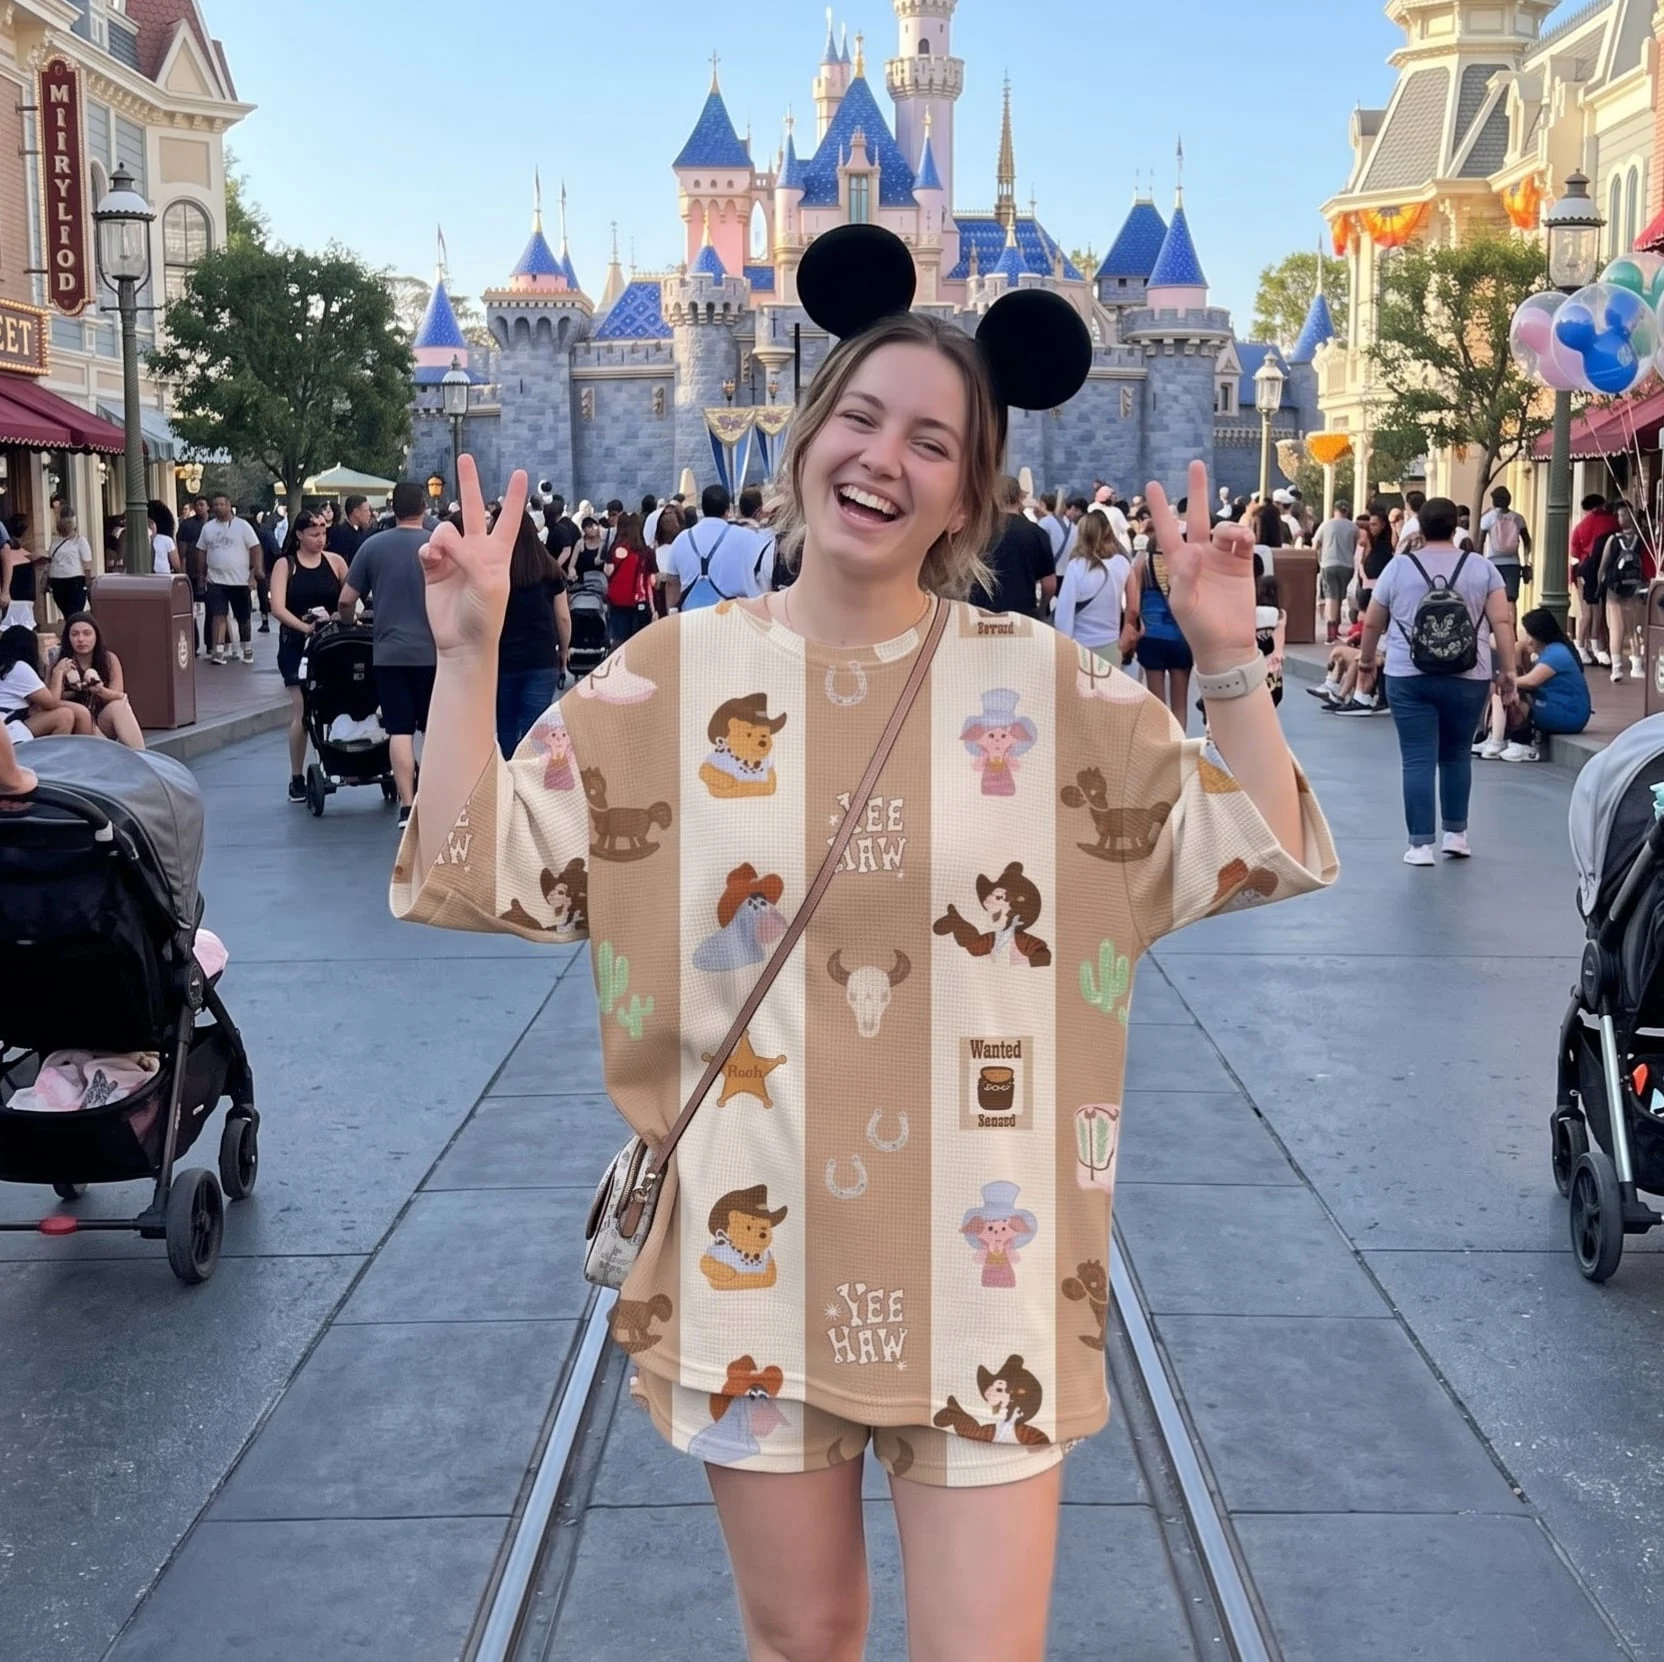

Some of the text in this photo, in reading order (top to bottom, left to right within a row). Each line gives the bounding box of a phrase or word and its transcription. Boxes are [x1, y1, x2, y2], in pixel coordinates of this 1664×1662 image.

[970, 1039, 1022, 1059] Wanted
[836, 1282, 904, 1327] YEE
[827, 1326, 908, 1365] HAW
